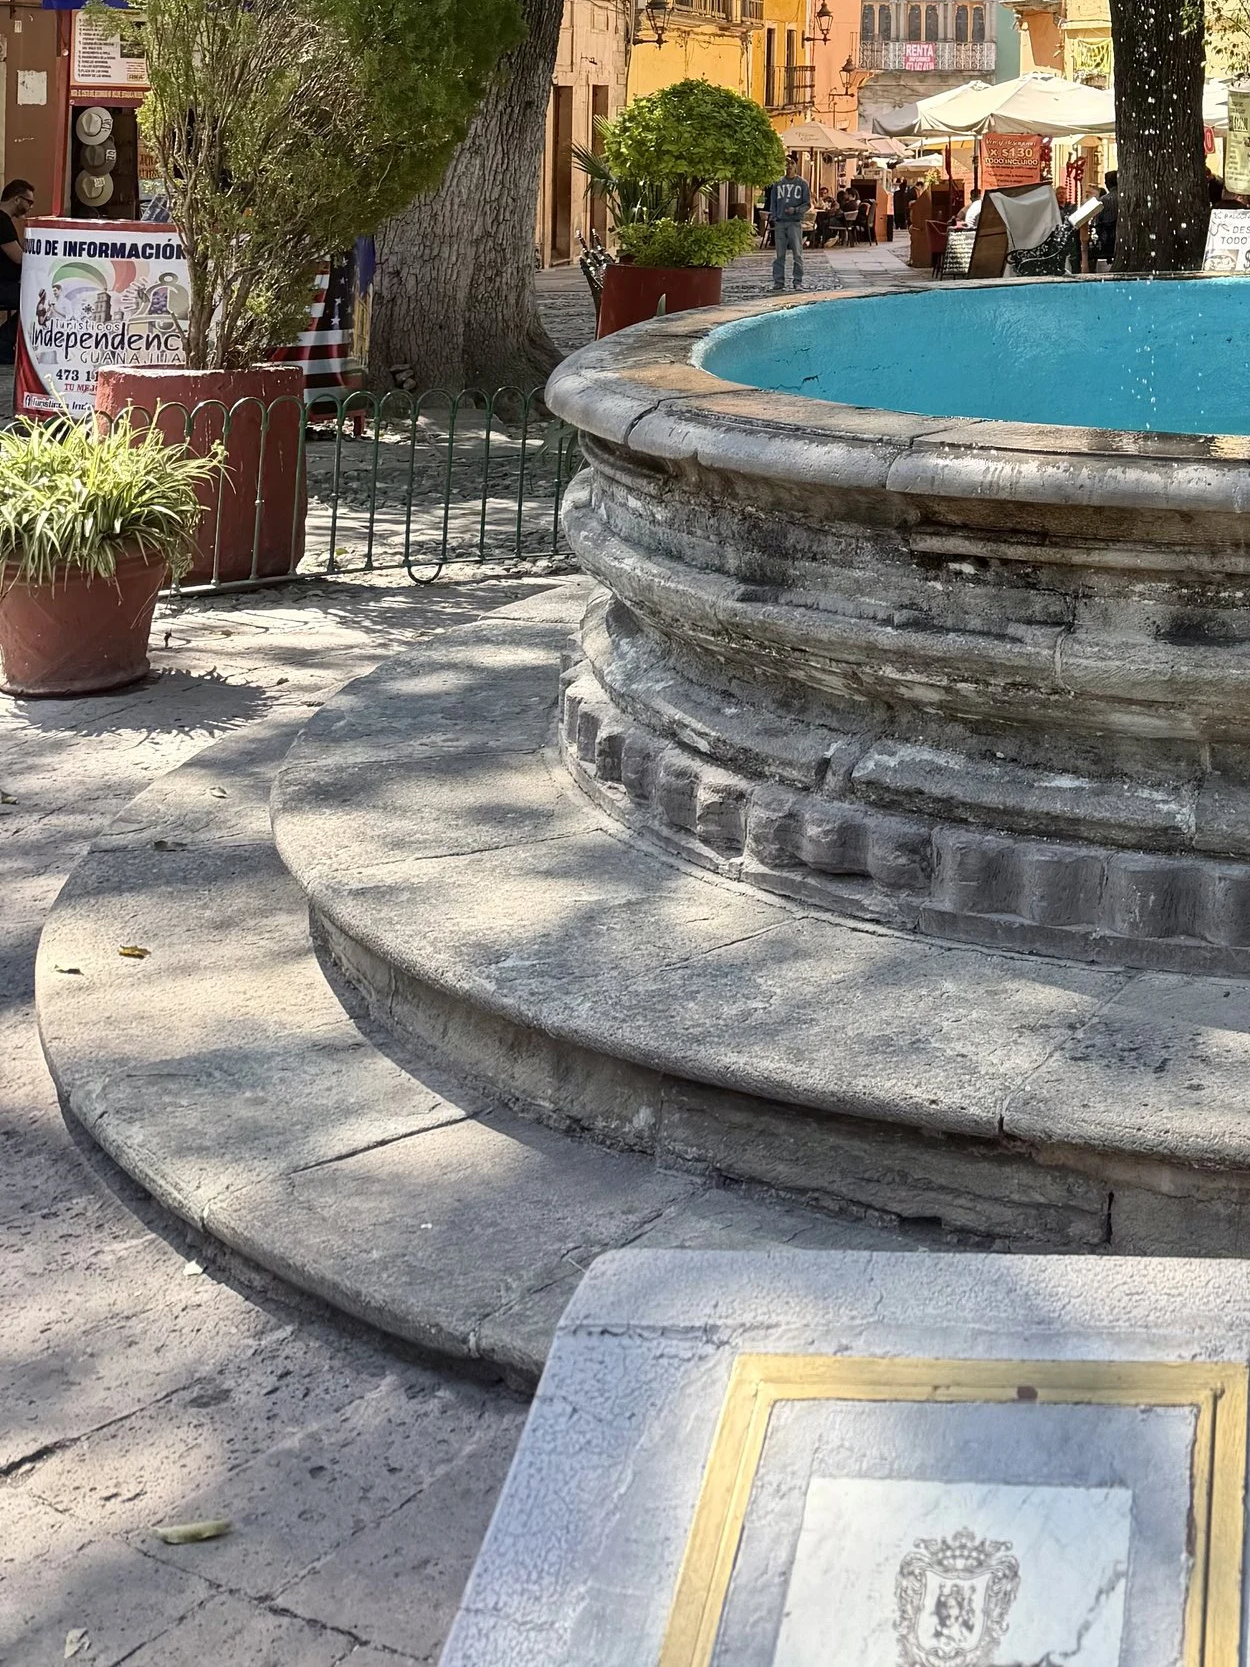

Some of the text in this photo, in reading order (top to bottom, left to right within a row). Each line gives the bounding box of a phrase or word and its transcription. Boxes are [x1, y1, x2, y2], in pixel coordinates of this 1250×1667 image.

[906, 44, 934, 57] RENTA
[1002, 147, 1033, 158] $130
[777, 184, 802, 199] NYC
[1221, 236, 1248, 245] TODO
[45, 240, 58, 256] DE
[56, 369, 80, 381] 473
[64, 383, 75, 391] TU
